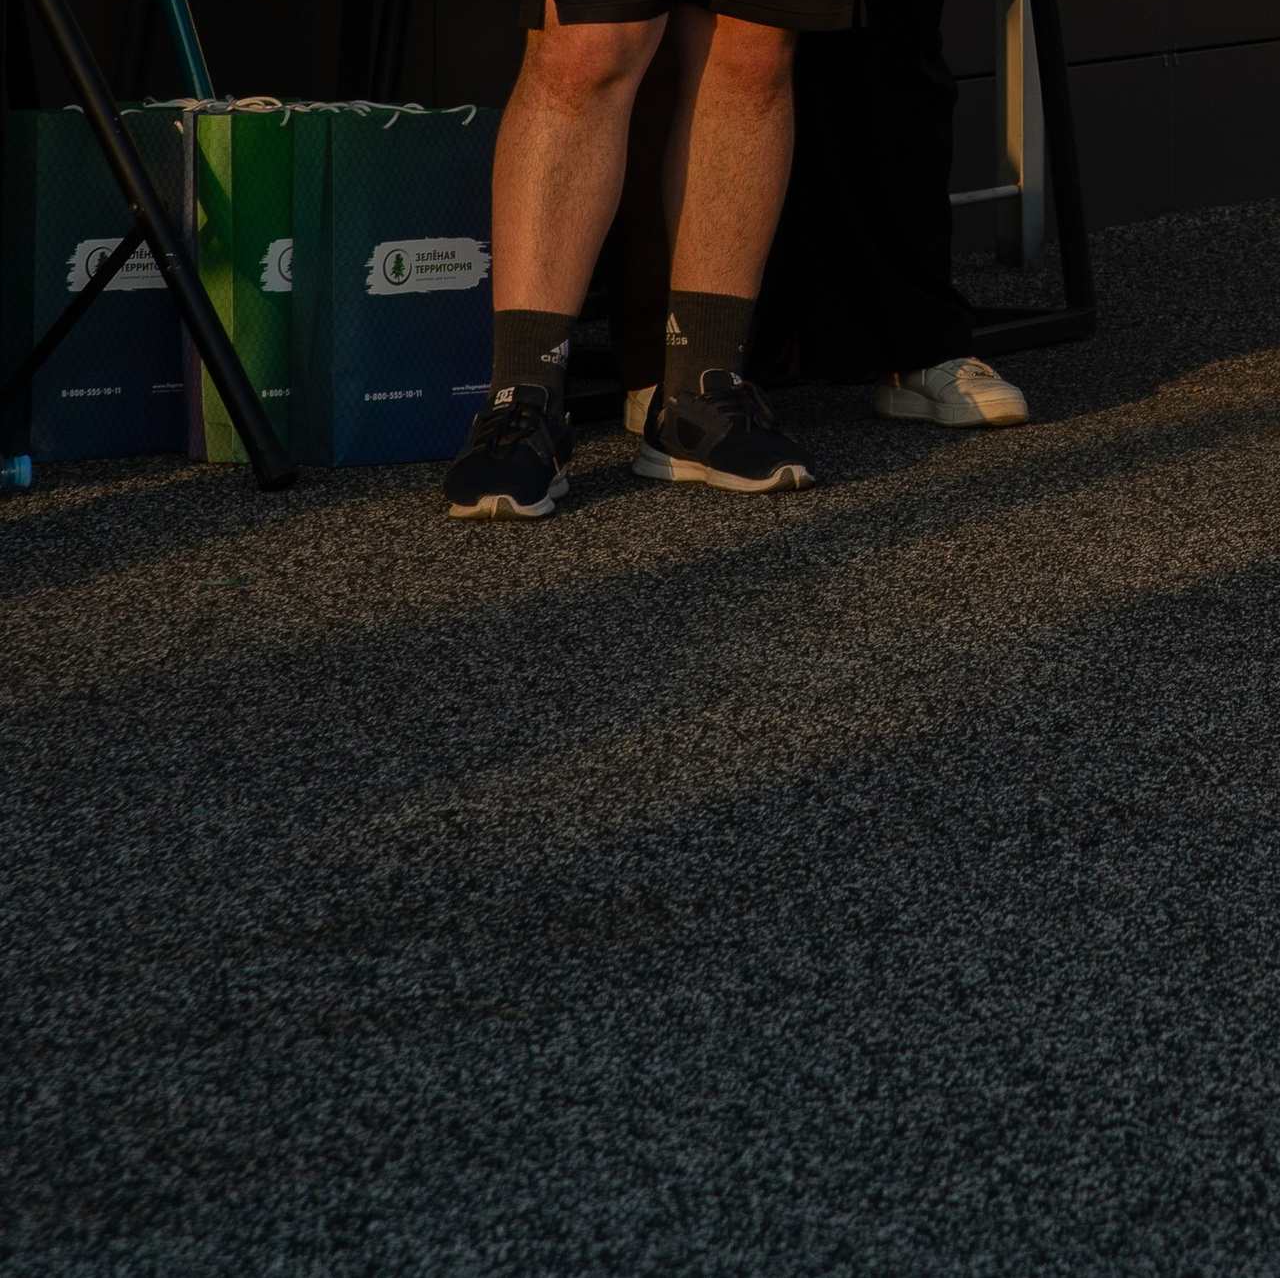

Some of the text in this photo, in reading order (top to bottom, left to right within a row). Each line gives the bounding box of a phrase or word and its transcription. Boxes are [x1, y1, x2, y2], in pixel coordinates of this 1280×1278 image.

[415, 249, 456, 262] ЗЕЛЁНАЯ
[415, 261, 472, 274] ТЕРРИТОРИЯ
[61, 386, 122, 398] 8-800-555-10-11
[364, 389, 423, 402] 8-800-555-10-11
